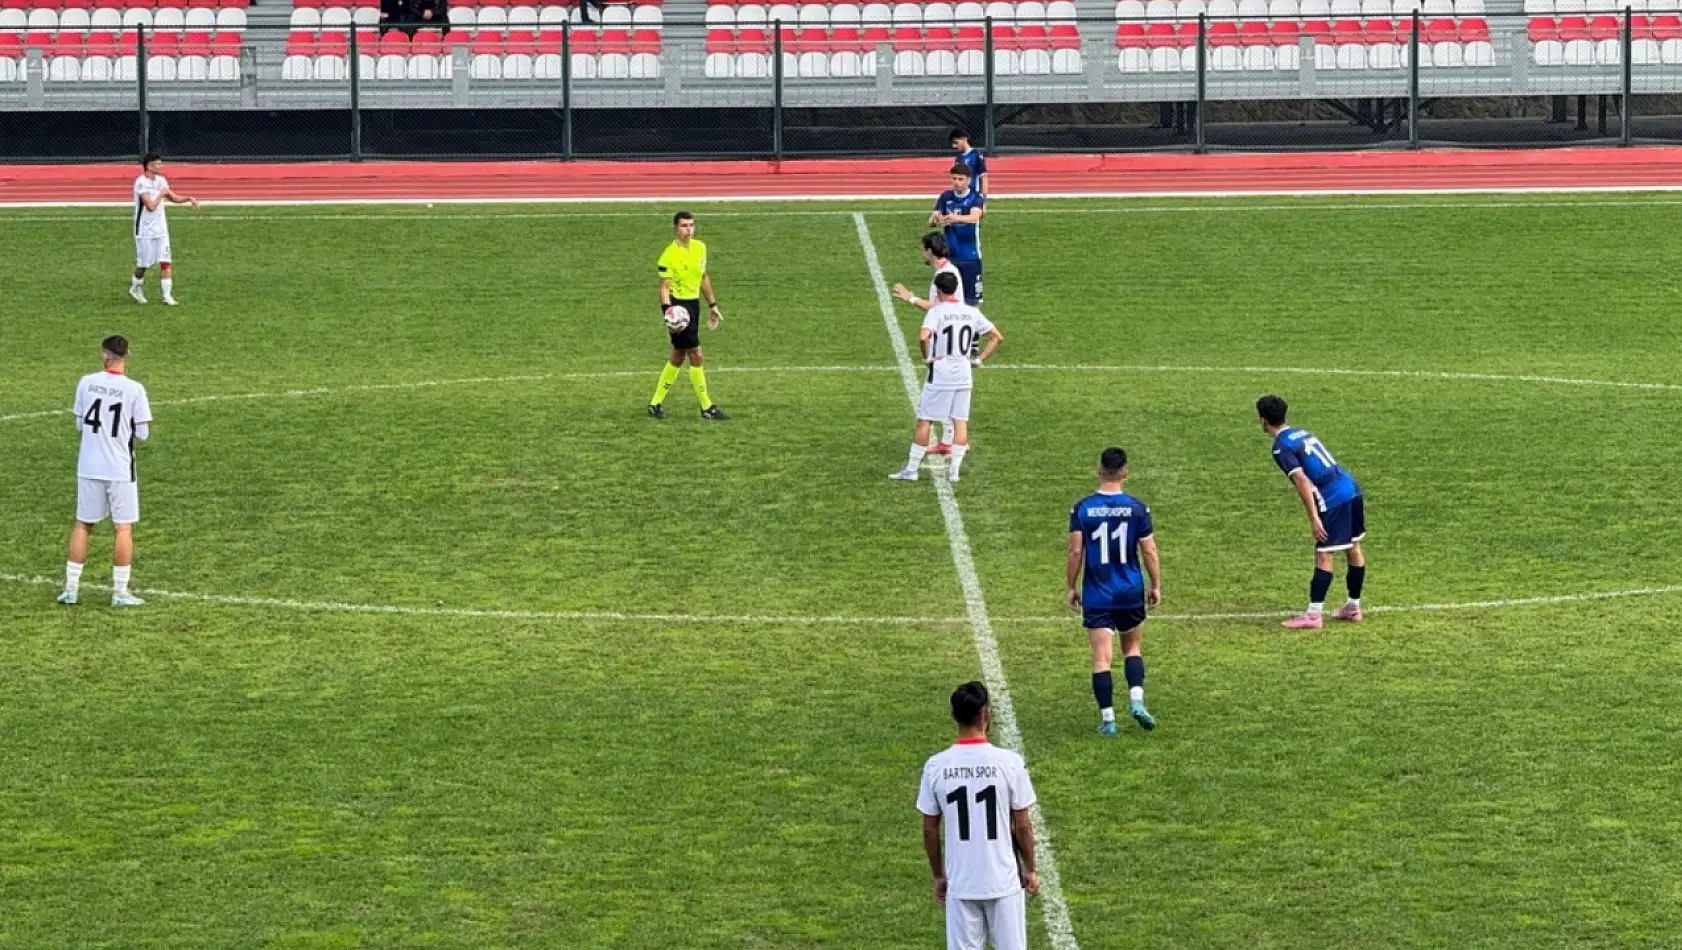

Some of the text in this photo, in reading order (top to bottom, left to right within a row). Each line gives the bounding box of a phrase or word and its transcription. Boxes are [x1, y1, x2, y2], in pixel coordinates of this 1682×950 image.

[942, 324, 972, 356] 10
[84, 397, 123, 438] 41
[1091, 521, 1129, 565] 11
[943, 766, 997, 780] BARTIN SPOR
[946, 784, 998, 841] 11
